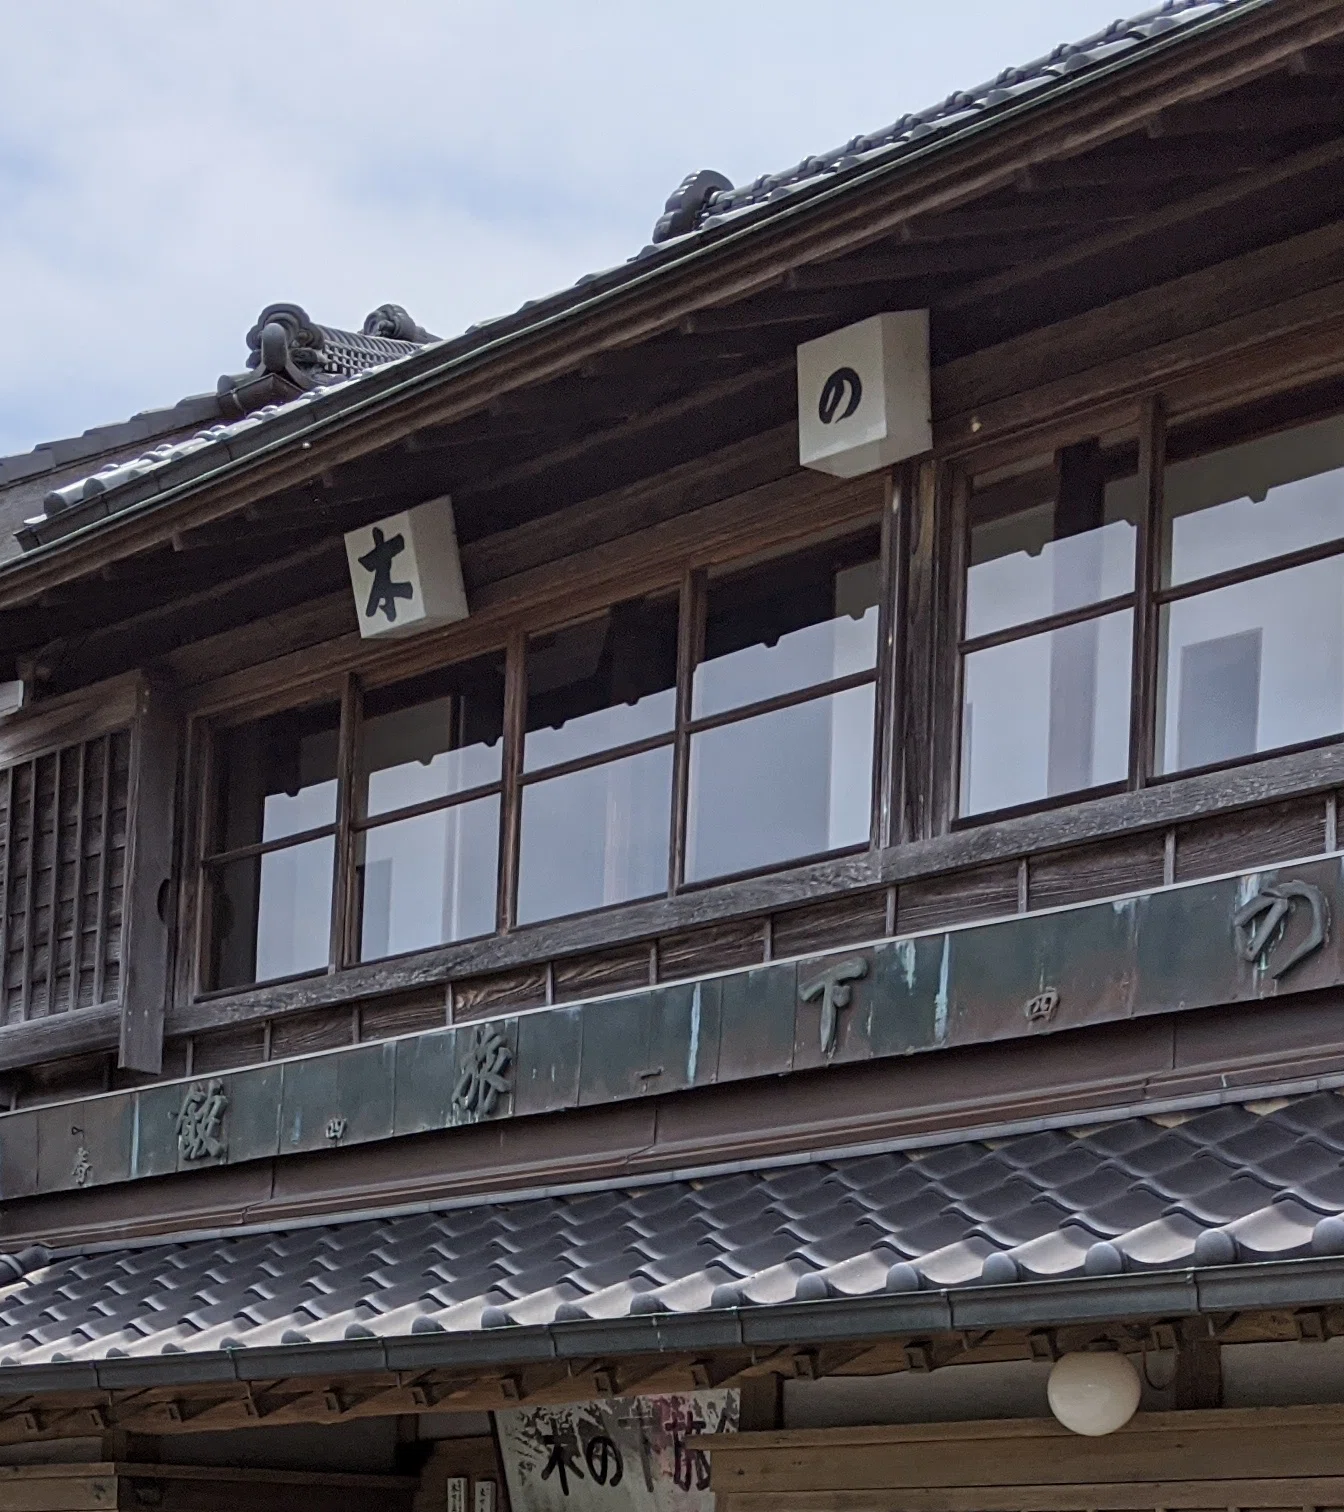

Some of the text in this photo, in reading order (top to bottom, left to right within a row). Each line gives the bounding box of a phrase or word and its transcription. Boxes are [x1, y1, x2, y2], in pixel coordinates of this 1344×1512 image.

[358, 526, 413, 622] 木
[818, 366, 863, 425] の
[798, 957, 869, 1053] 下
